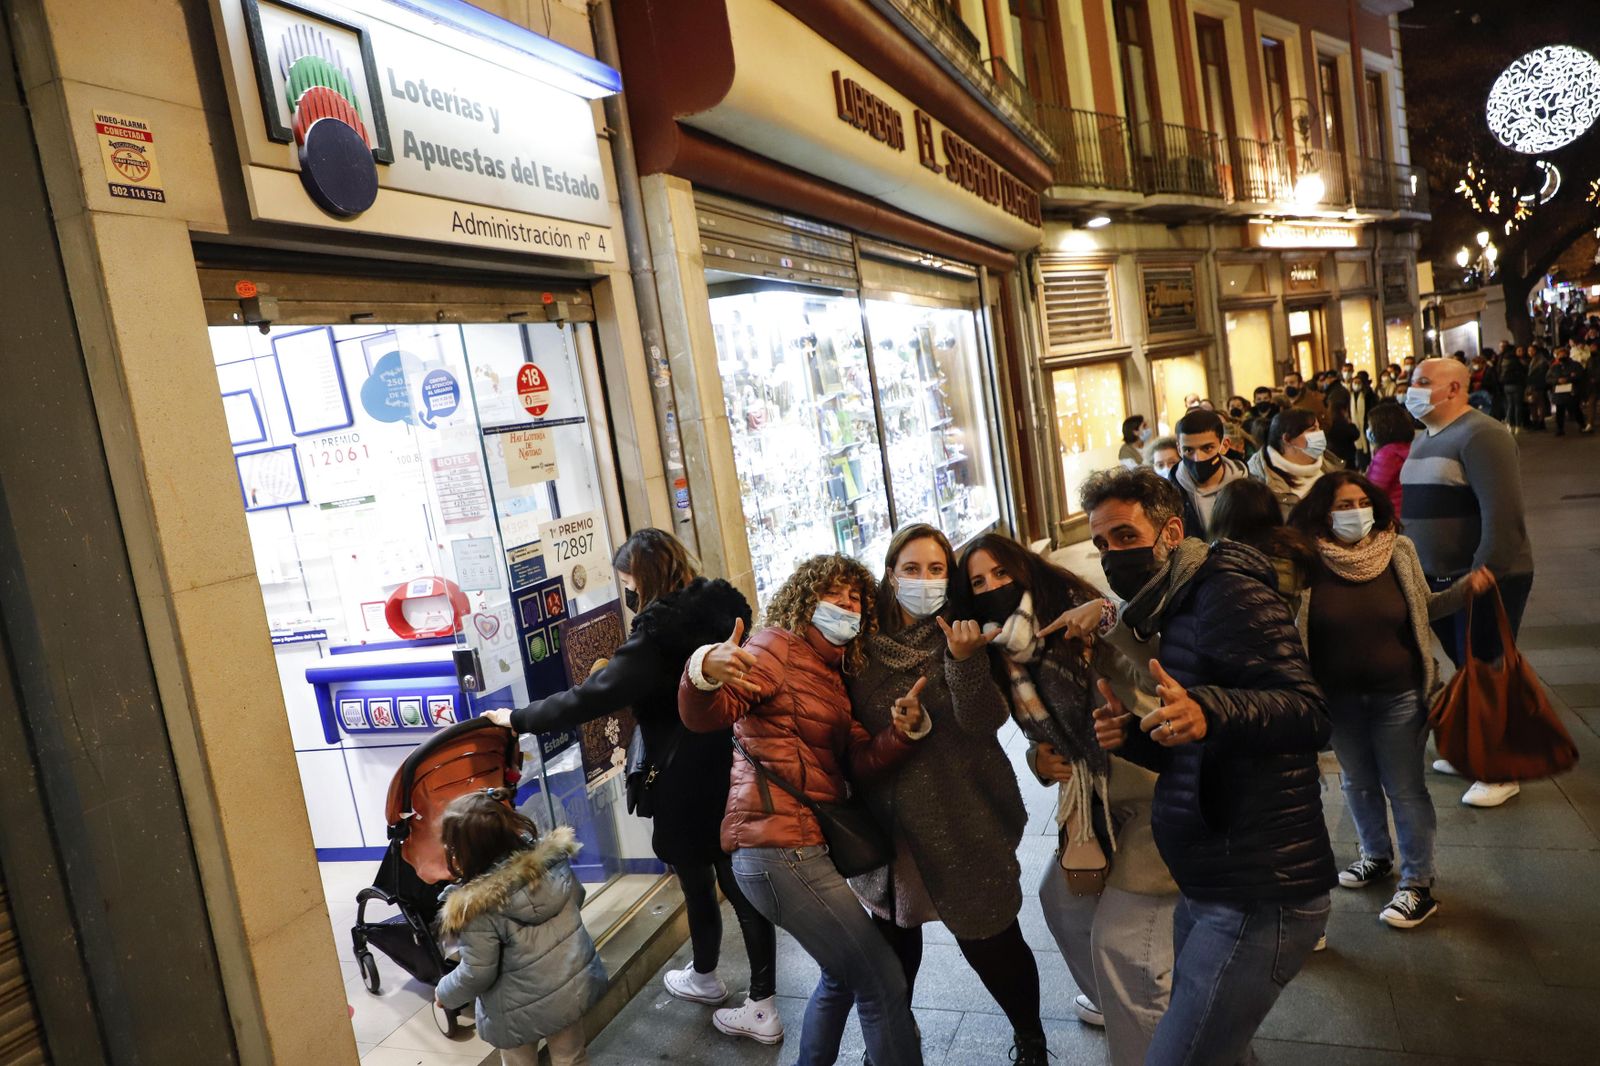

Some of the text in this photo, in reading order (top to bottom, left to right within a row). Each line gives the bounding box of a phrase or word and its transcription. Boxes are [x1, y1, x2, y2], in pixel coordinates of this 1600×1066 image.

[387, 67, 501, 135] Loterías y
[97, 114, 147, 130] VIDEO-ALARMA
[104, 126, 145, 140] CONECTADA
[913, 108, 944, 176] EL
[402, 129, 601, 202] Apuestas del Estado
[112, 186, 163, 201] 902 114 573
[451, 210, 572, 251] Administración
[597, 233, 607, 254] 4
[520, 367, 542, 387] +18
[321, 433, 360, 447] PREMIO
[309, 444, 370, 468] 12061
[436, 454, 472, 467] BOTES
[558, 517, 594, 537] PREMIO
[553, 532, 595, 563] 72897
[543, 731, 570, 753] Estado
